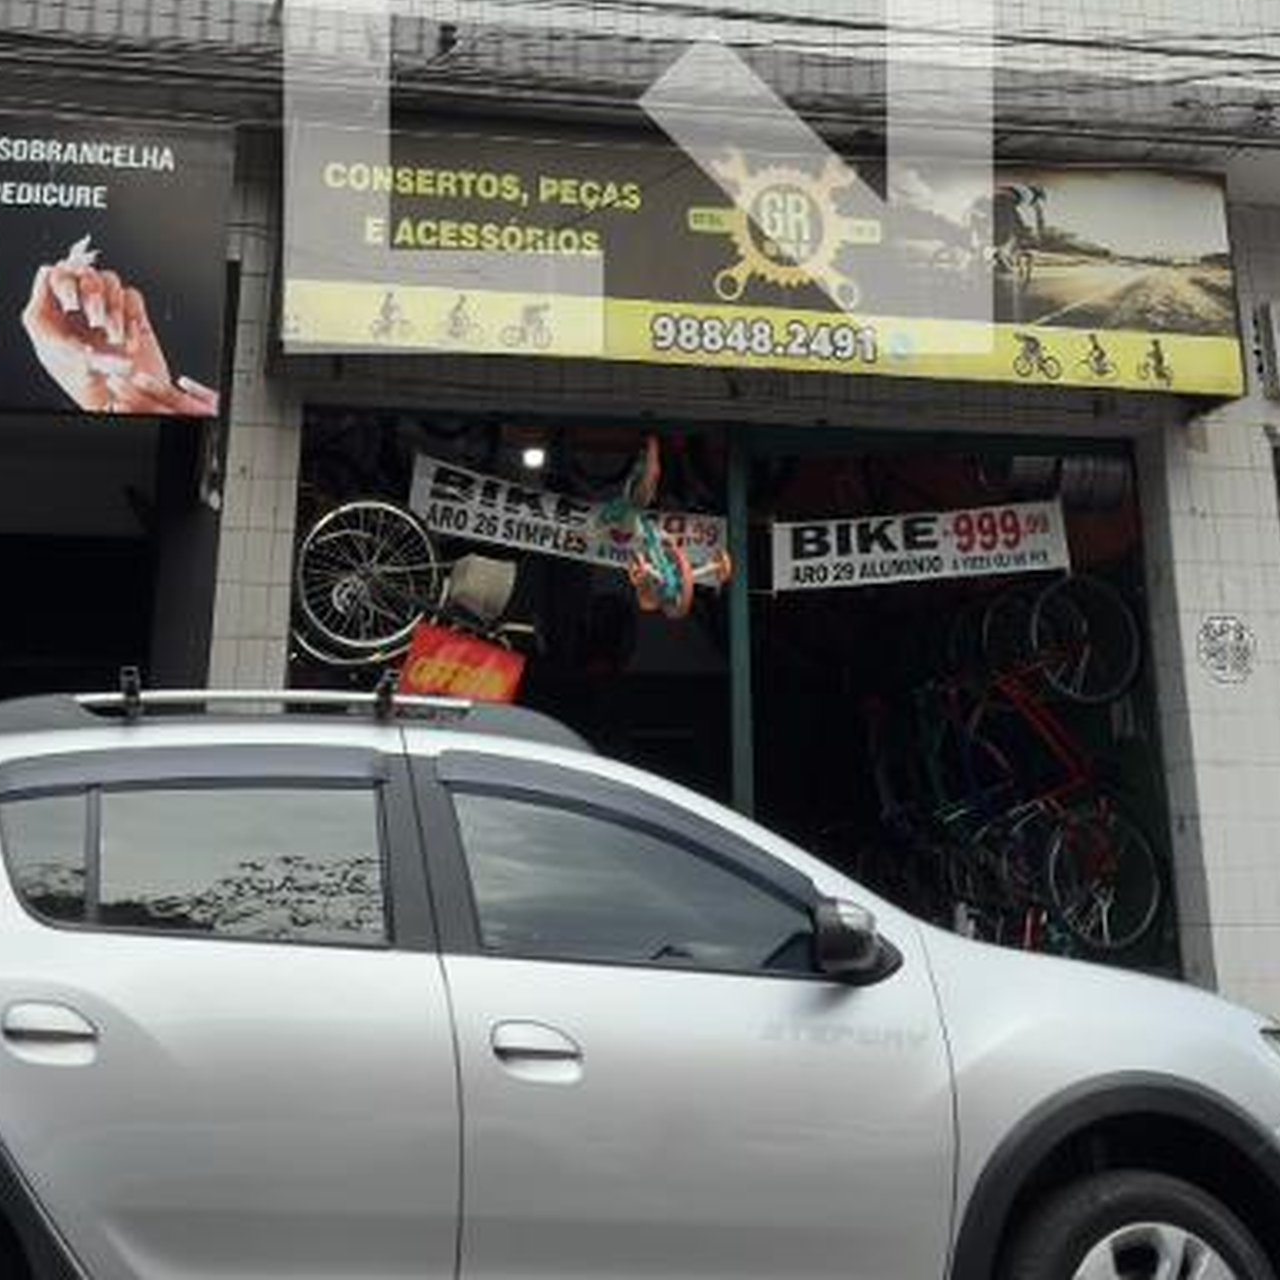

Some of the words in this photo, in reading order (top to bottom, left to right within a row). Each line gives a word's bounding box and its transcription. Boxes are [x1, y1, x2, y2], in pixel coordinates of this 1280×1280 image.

[324, 163, 529, 207] CONSERTOS,
[538, 176, 642, 213] PEÇAS
[365, 217, 385, 246] E
[393, 216, 601, 255] ACESSÓRIOS
[759, 192, 811, 242] GR
[651, 314, 877, 362] 98848.2491
[426, 503, 468, 531] ARO
[501, 515, 588, 556] SIMPLES
[792, 516, 939, 560] BIKE
[792, 564, 829, 585] ARO
